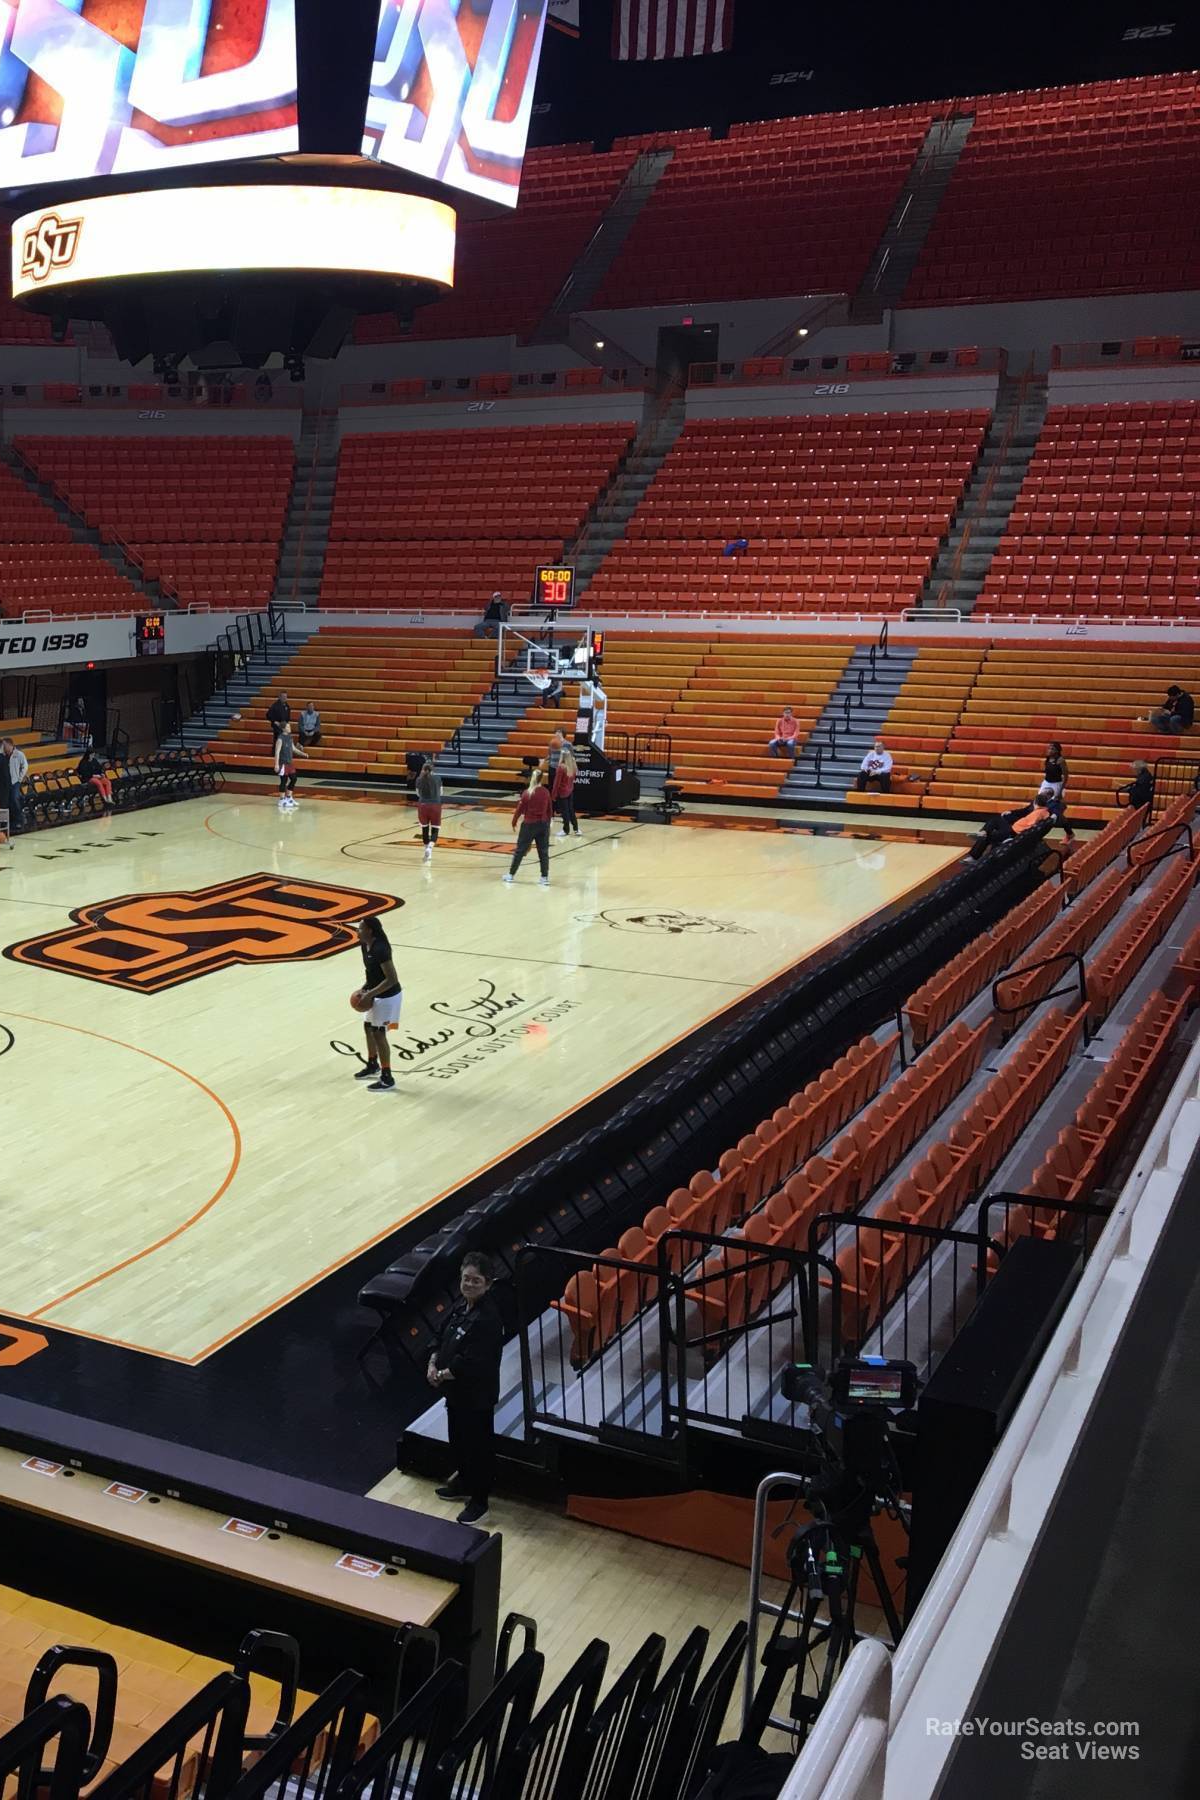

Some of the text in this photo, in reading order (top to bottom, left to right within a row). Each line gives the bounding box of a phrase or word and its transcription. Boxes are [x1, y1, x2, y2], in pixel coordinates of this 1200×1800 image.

[1121, 24, 1176, 40] 325
[770, 69, 814, 85] 324
[22, 214, 82, 281] OSU
[814, 384, 851, 395] 218
[138, 410, 166, 419] 216
[467, 401, 496, 412] 217
[541, 571, 571, 581] 60:00
[544, 582, 566, 601] 30
[42, 633, 89, 651] 1938
[35, 878, 373, 983] OSU
[428, 999, 584, 1080] EDDIE SUTTON COURT
